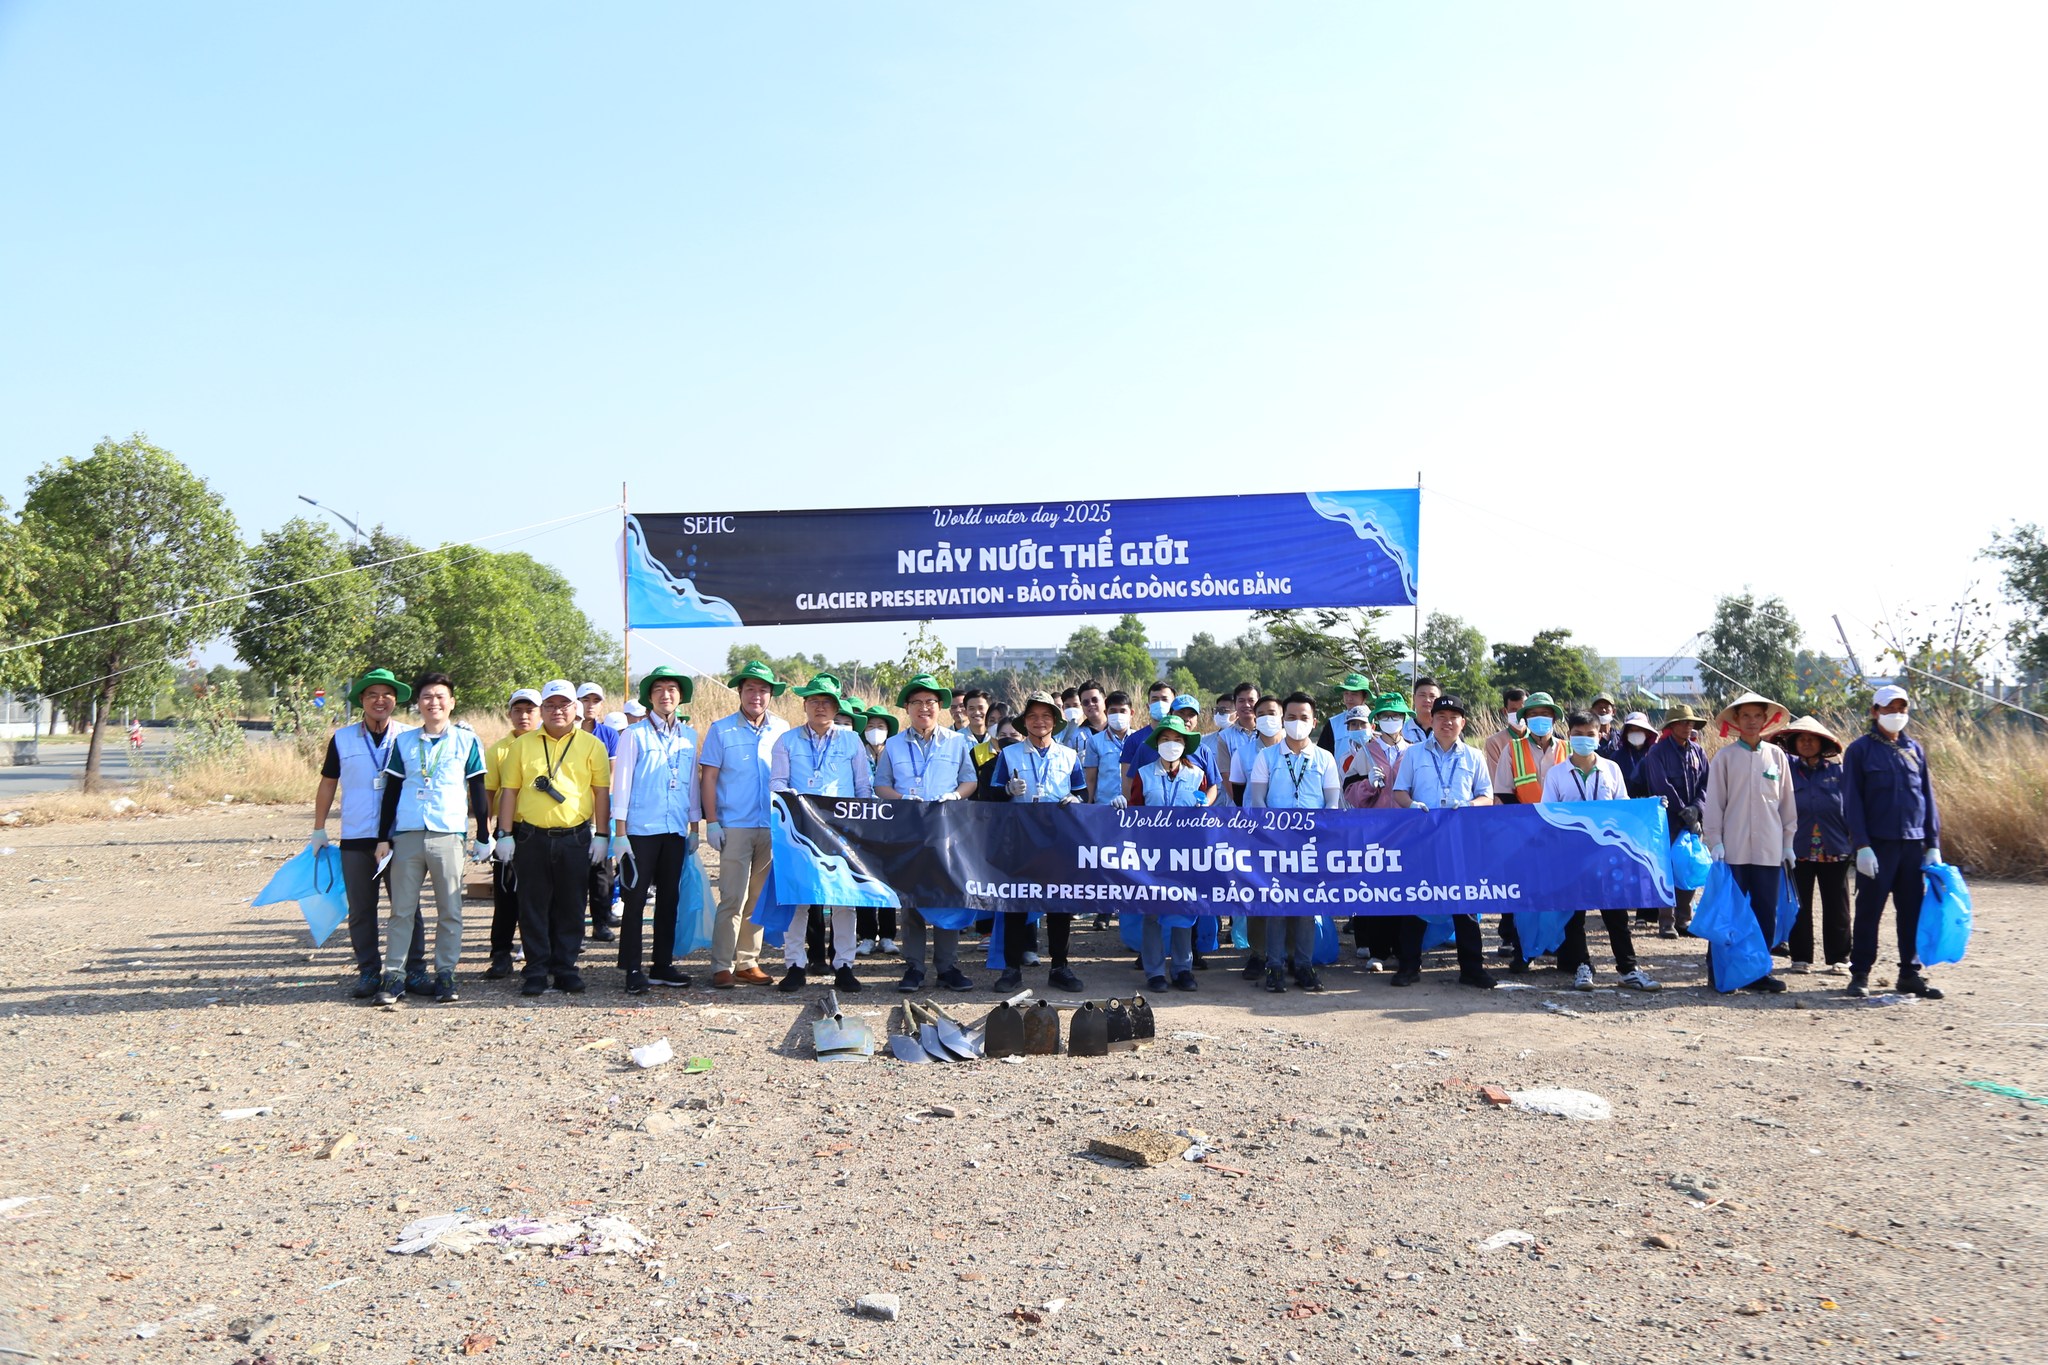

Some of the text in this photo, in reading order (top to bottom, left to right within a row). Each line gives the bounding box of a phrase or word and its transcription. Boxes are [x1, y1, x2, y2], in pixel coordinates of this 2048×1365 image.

[684, 516, 735, 534] SEHC
[933, 503, 1110, 528] World water day 2025
[898, 529, 1189, 573] NGÀY NƯỚC THẾ GIỚI
[796, 592, 868, 610] GLACIER
[871, 587, 1003, 607] PRESERVATION
[1017, 579, 1055, 602] BẢO
[1058, 573, 1096, 601] TỒN
[1099, 575, 1132, 600] CÁC
[1136, 574, 1187, 599] DÒNG
[1191, 573, 1239, 597] SÔNG
[1243, 571, 1291, 596] BĂNG
[834, 801, 894, 820] SEHC
[1117, 809, 1316, 834] World water day 2025
[1079, 837, 1402, 873] NGÀY NƯỚC THẾ GIỚI
[966, 880, 1042, 899] GLACIER
[1047, 884, 1197, 901] PRESERVATION
[1213, 880, 1254, 902] BẢO
[1259, 877, 1298, 903] TỒN
[1303, 881, 1339, 902] CÁC
[1344, 881, 1401, 902] DÒNG
[1406, 880, 1460, 901] SÔNG
[1465, 879, 1520, 900] BĂNG
